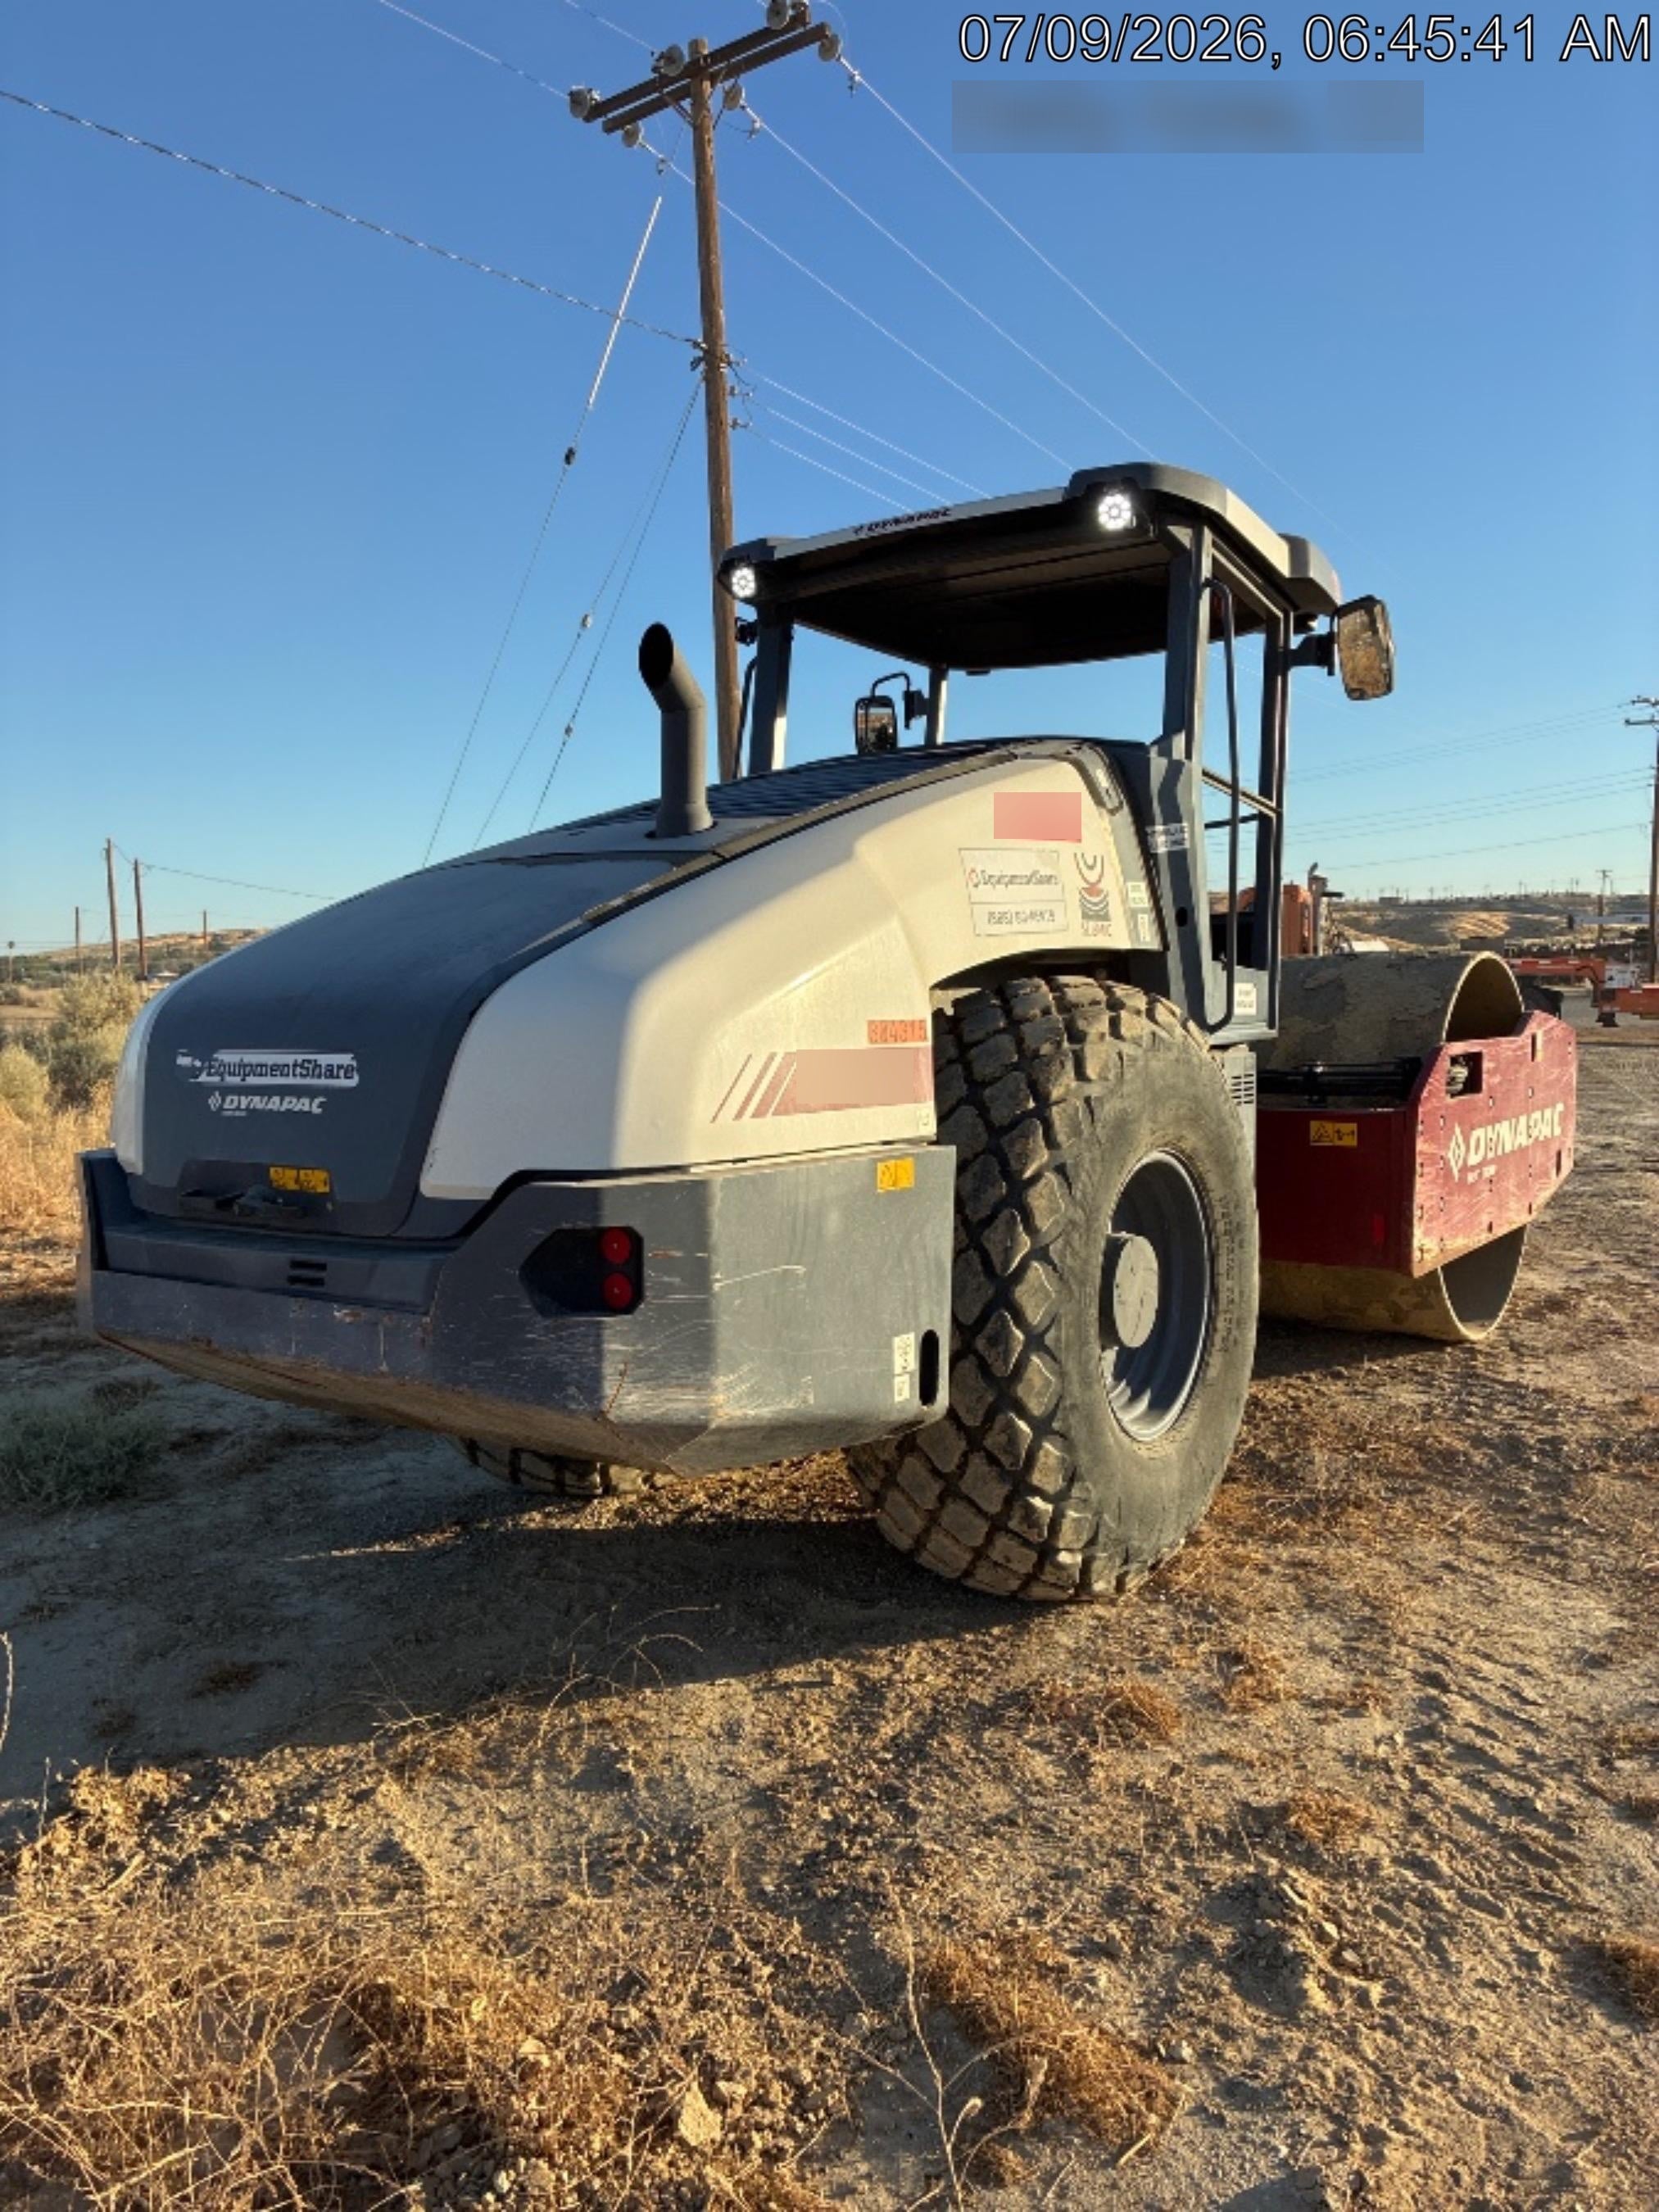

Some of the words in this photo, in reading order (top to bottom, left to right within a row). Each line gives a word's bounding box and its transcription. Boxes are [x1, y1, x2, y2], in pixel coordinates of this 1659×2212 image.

[206, 1058, 356, 1082] EquipmentShare
[222, 1095, 327, 1114] DYNAPAC
[1466, 1103, 1565, 1167] DYNAPAC
